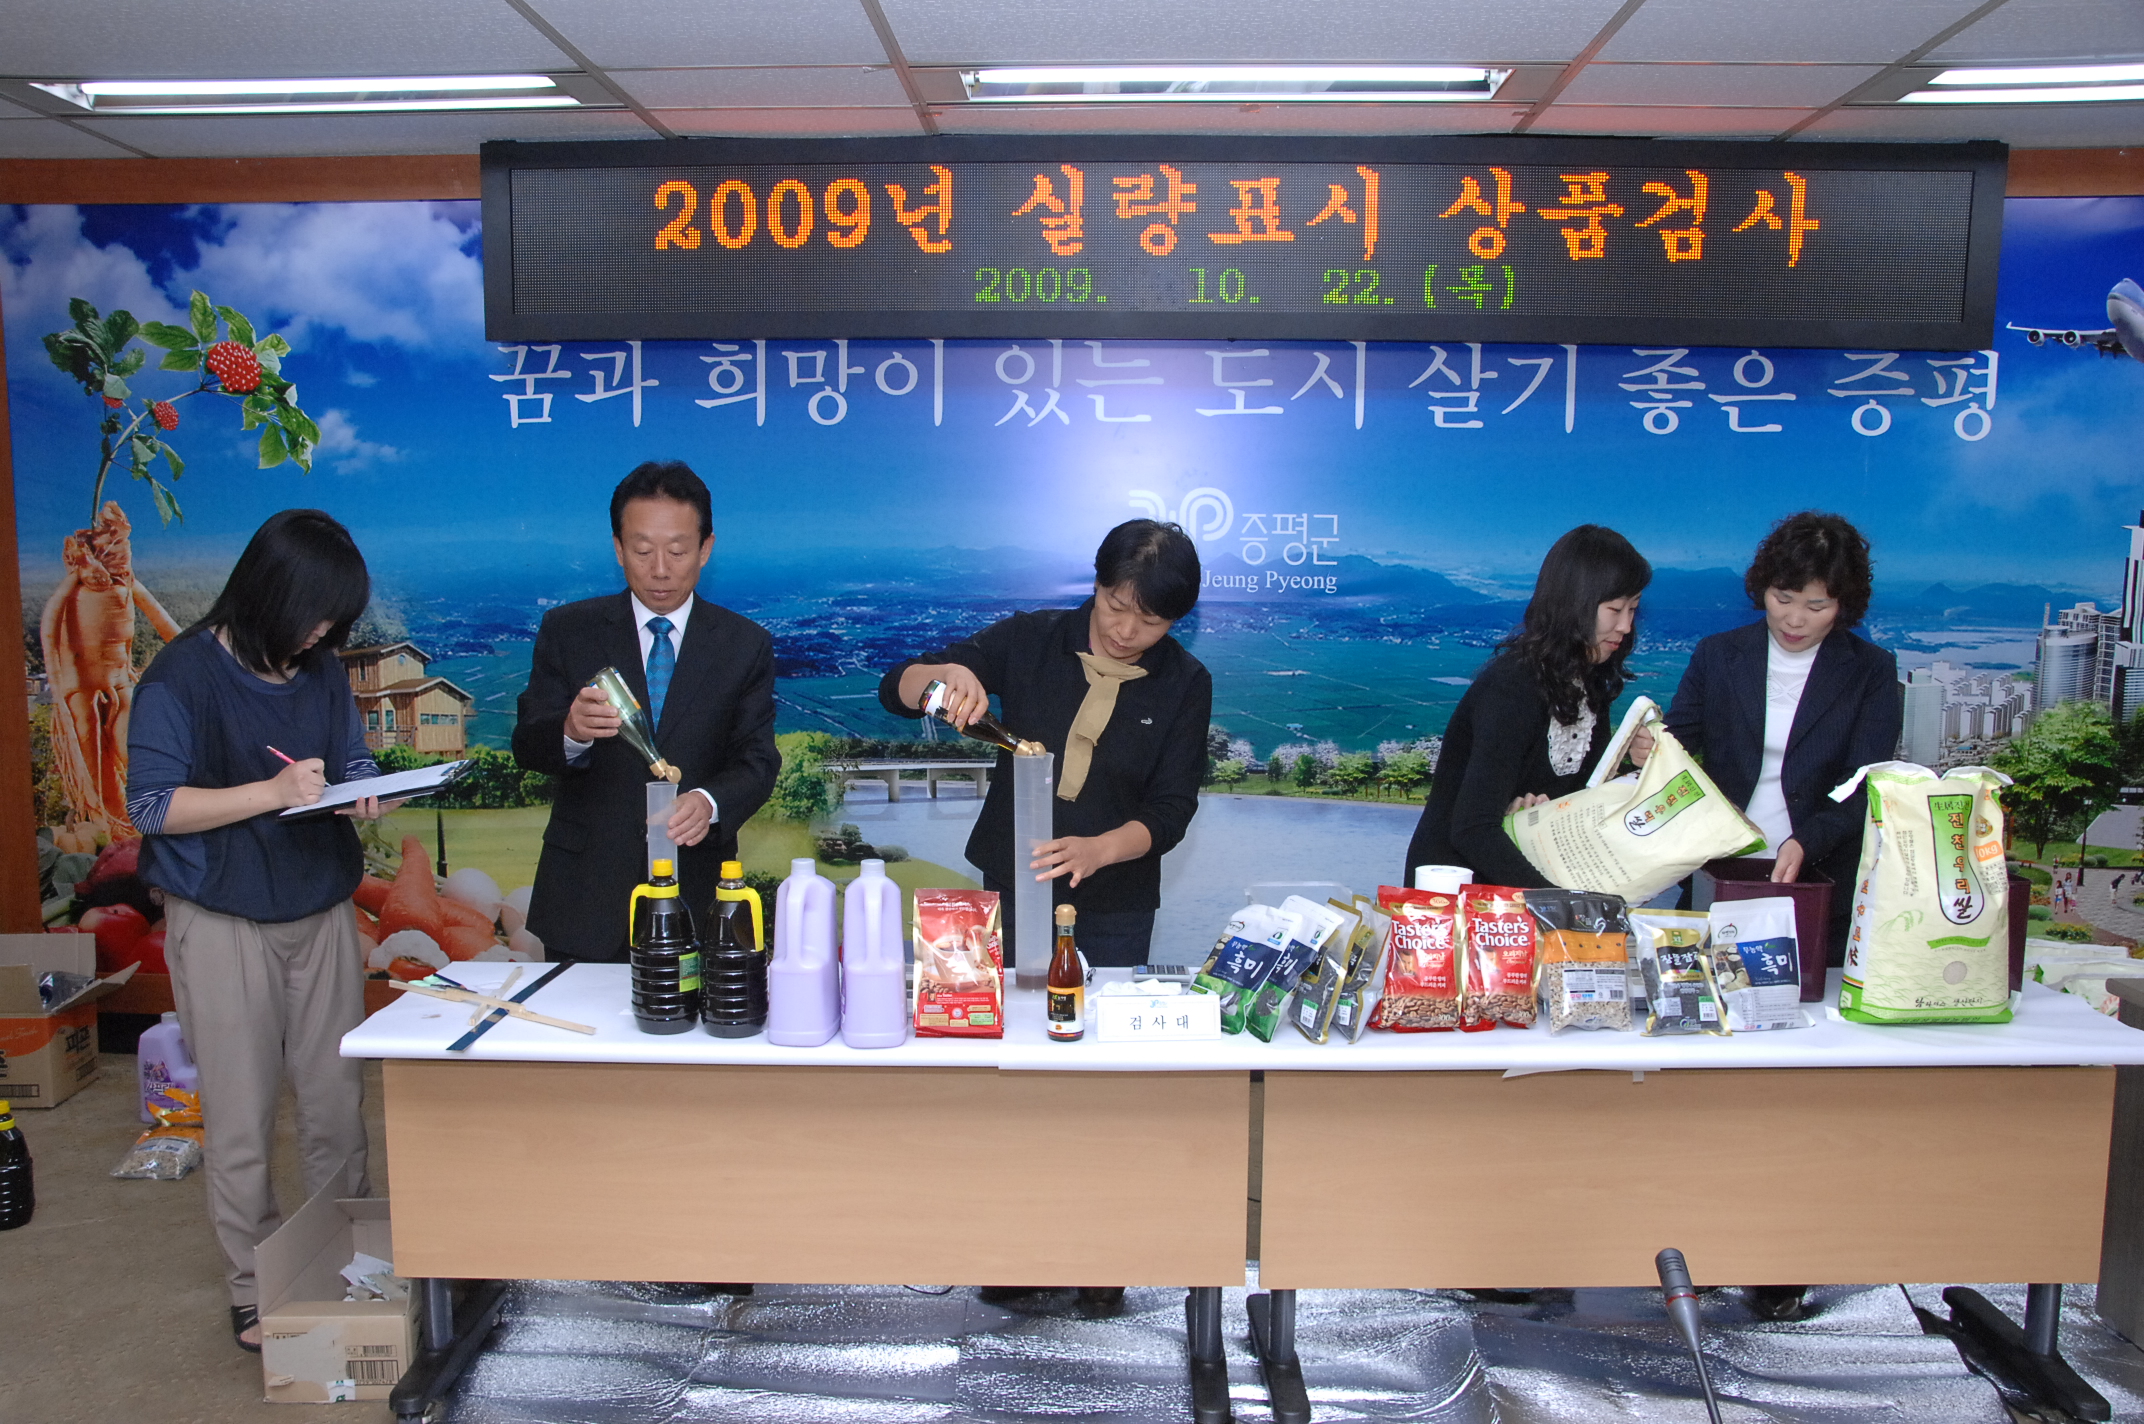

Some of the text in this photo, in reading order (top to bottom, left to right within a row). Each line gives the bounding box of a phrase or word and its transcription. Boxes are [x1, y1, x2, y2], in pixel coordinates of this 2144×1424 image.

[653, 164, 1820, 268] 2009년 실량표시 상품검사
[974, 264, 1516, 310] 2009. 10. 22. (목)
[489, 340, 2000, 443] 꿈과 희망이 있는 도시 살기 좋은 증평
[1239, 513, 1340, 566] 증평군
[1202, 570, 1338, 593] Jeung Pyeong
[1391, 917, 1448, 938] Taster's
[1472, 915, 1530, 934] Taster's
[1394, 935, 1447, 950] Choice
[1475, 932, 1529, 947] Choice
[1761, 952, 1793, 976] 흑미
[1129, 1015, 1190, 1031] 검사대
